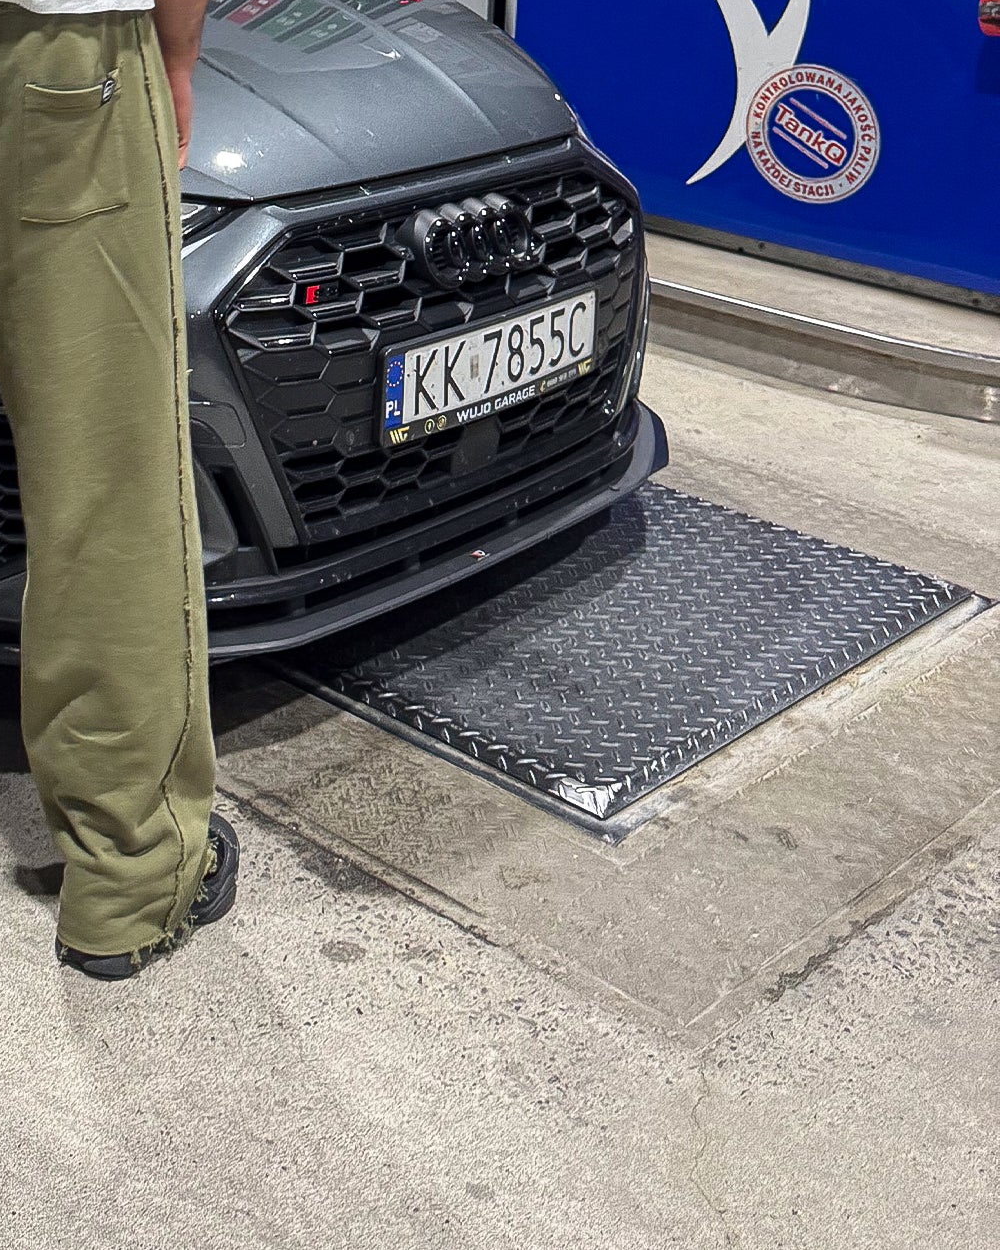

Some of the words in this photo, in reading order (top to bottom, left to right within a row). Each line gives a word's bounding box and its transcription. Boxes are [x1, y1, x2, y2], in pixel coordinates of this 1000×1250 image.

[753, 71, 843, 119] KONTROLOWANA
[843, 91, 876, 142] JAKOŚĆ
[777, 103, 846, 164] TankQ
[751, 131, 763, 149] NA
[792, 183, 835, 197] STACJI
[845, 145, 872, 184] PALIW
[413, 340, 466, 416] KK
[484, 301, 587, 394] 7855C
[386, 401, 400, 419] PL
[456, 401, 491, 423] WUJO
[494, 384, 536, 410] GARAGE
